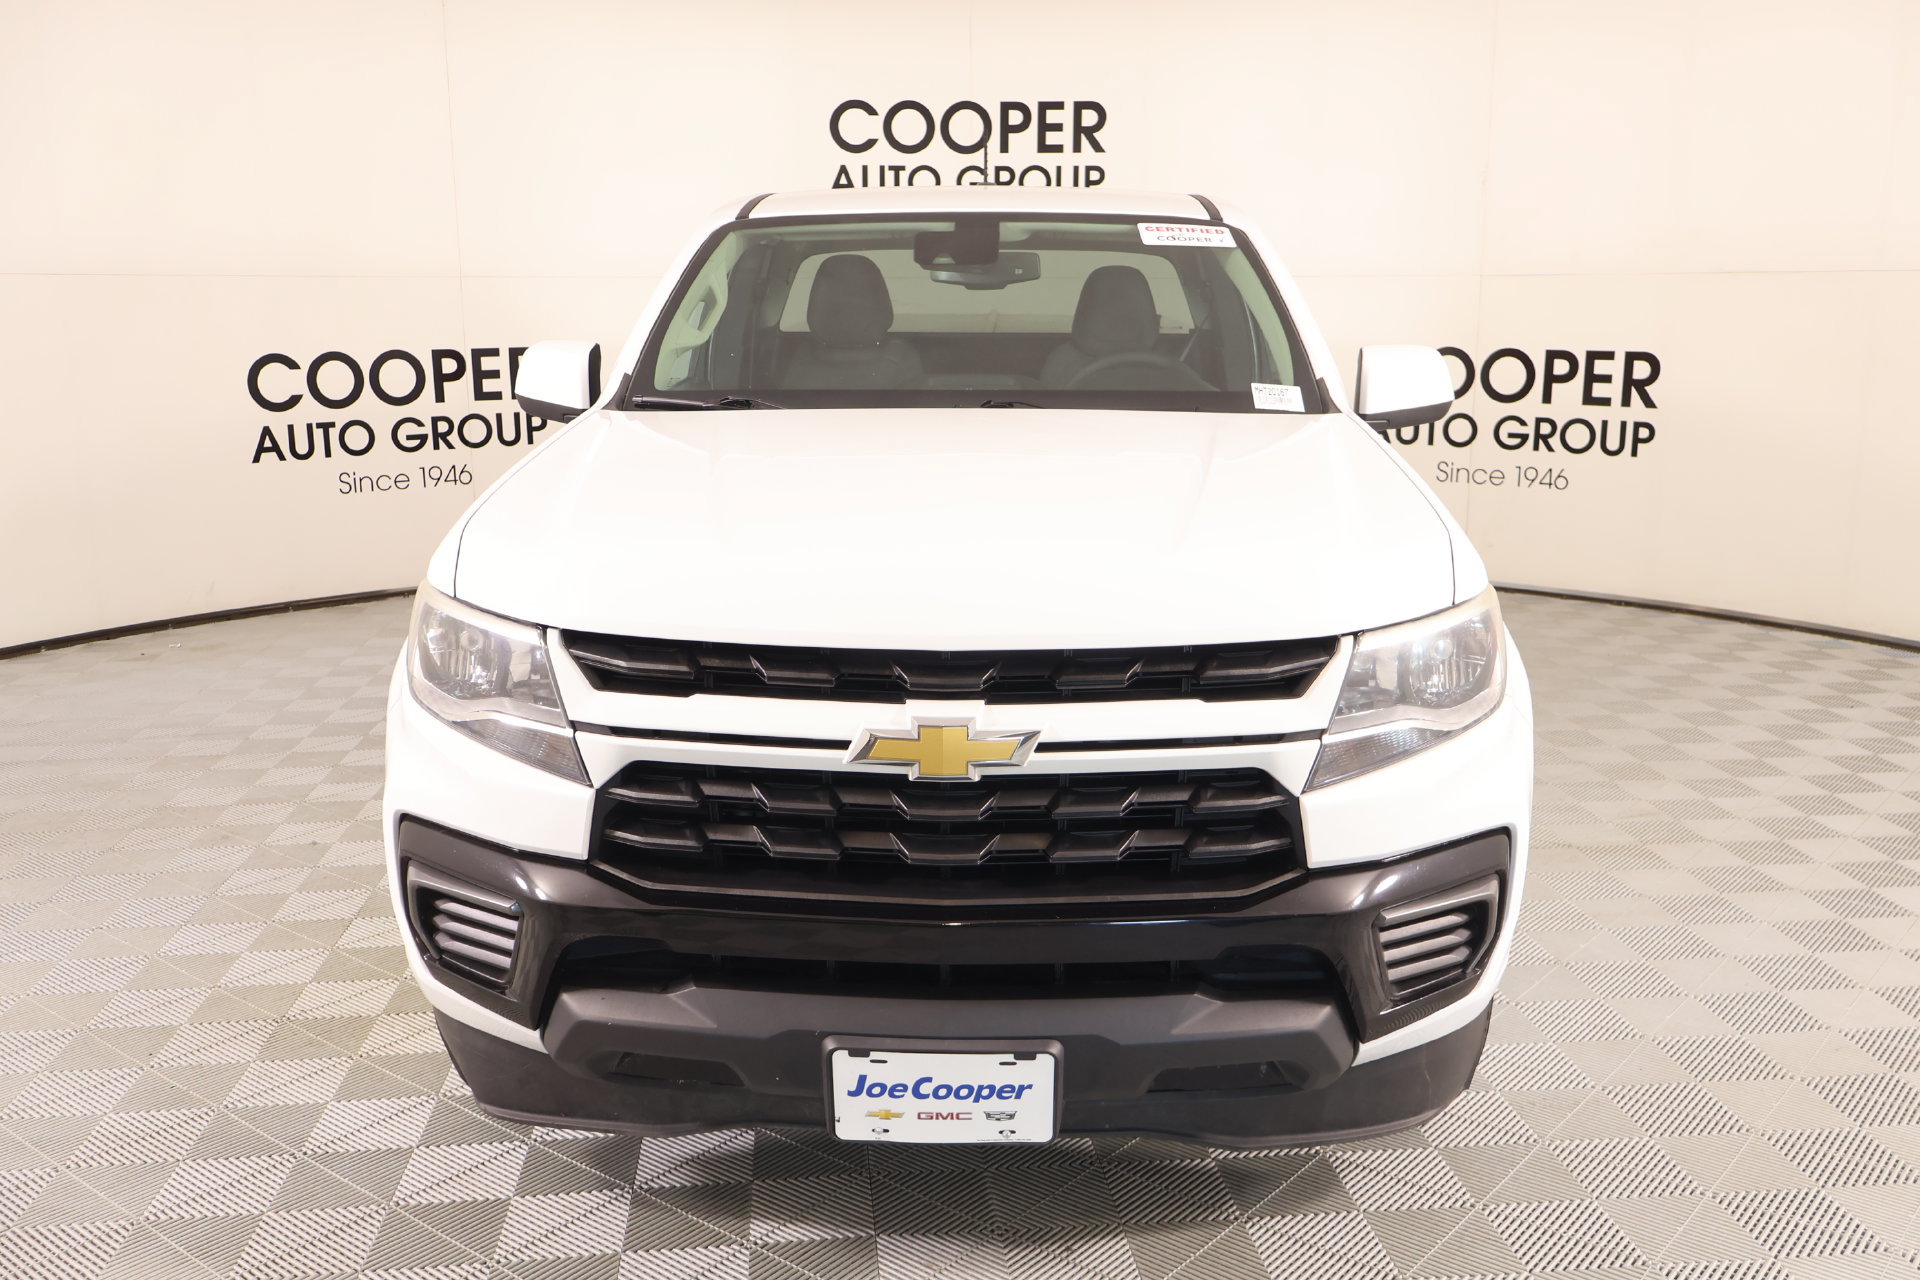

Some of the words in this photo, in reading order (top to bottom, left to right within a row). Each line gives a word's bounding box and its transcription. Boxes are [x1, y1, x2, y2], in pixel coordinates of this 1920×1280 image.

[829, 99, 1107, 154] COOPER
[831, 165, 941, 189] AUTO
[1144, 226, 1225, 235] CERTIFIED
[1157, 235, 1213, 243] COOPER
[252, 419, 376, 464] AUTO
[391, 412, 547, 453] GROUP
[1493, 415, 1656, 458] GROUP
[339, 471, 410, 495] Since
[419, 464, 473, 488] 1946
[1436, 461, 1505, 486] Since
[1515, 466, 1569, 490] 1946
[917, 1111, 973, 1121] GMC
